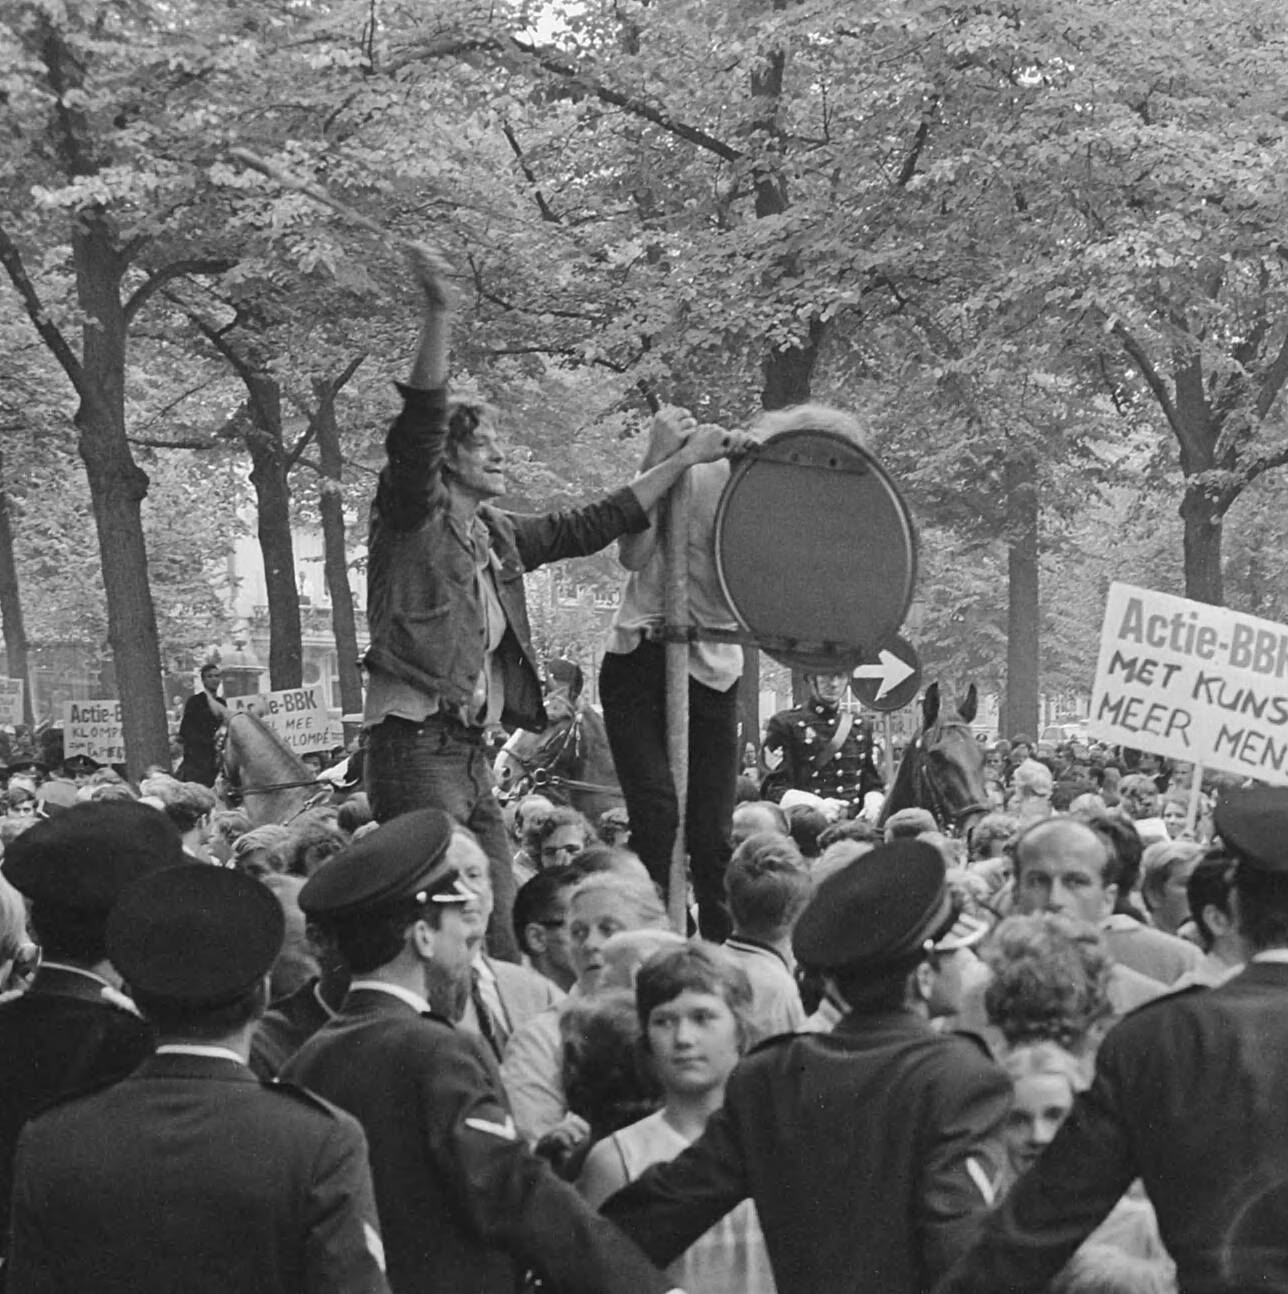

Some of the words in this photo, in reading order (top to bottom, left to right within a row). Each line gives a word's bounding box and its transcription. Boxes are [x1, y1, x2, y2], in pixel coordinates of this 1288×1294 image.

[1108, 650, 1182, 689] MET
[236, 690, 317, 715] Ae-BBK
[1097, 692, 1192, 748] MEER
